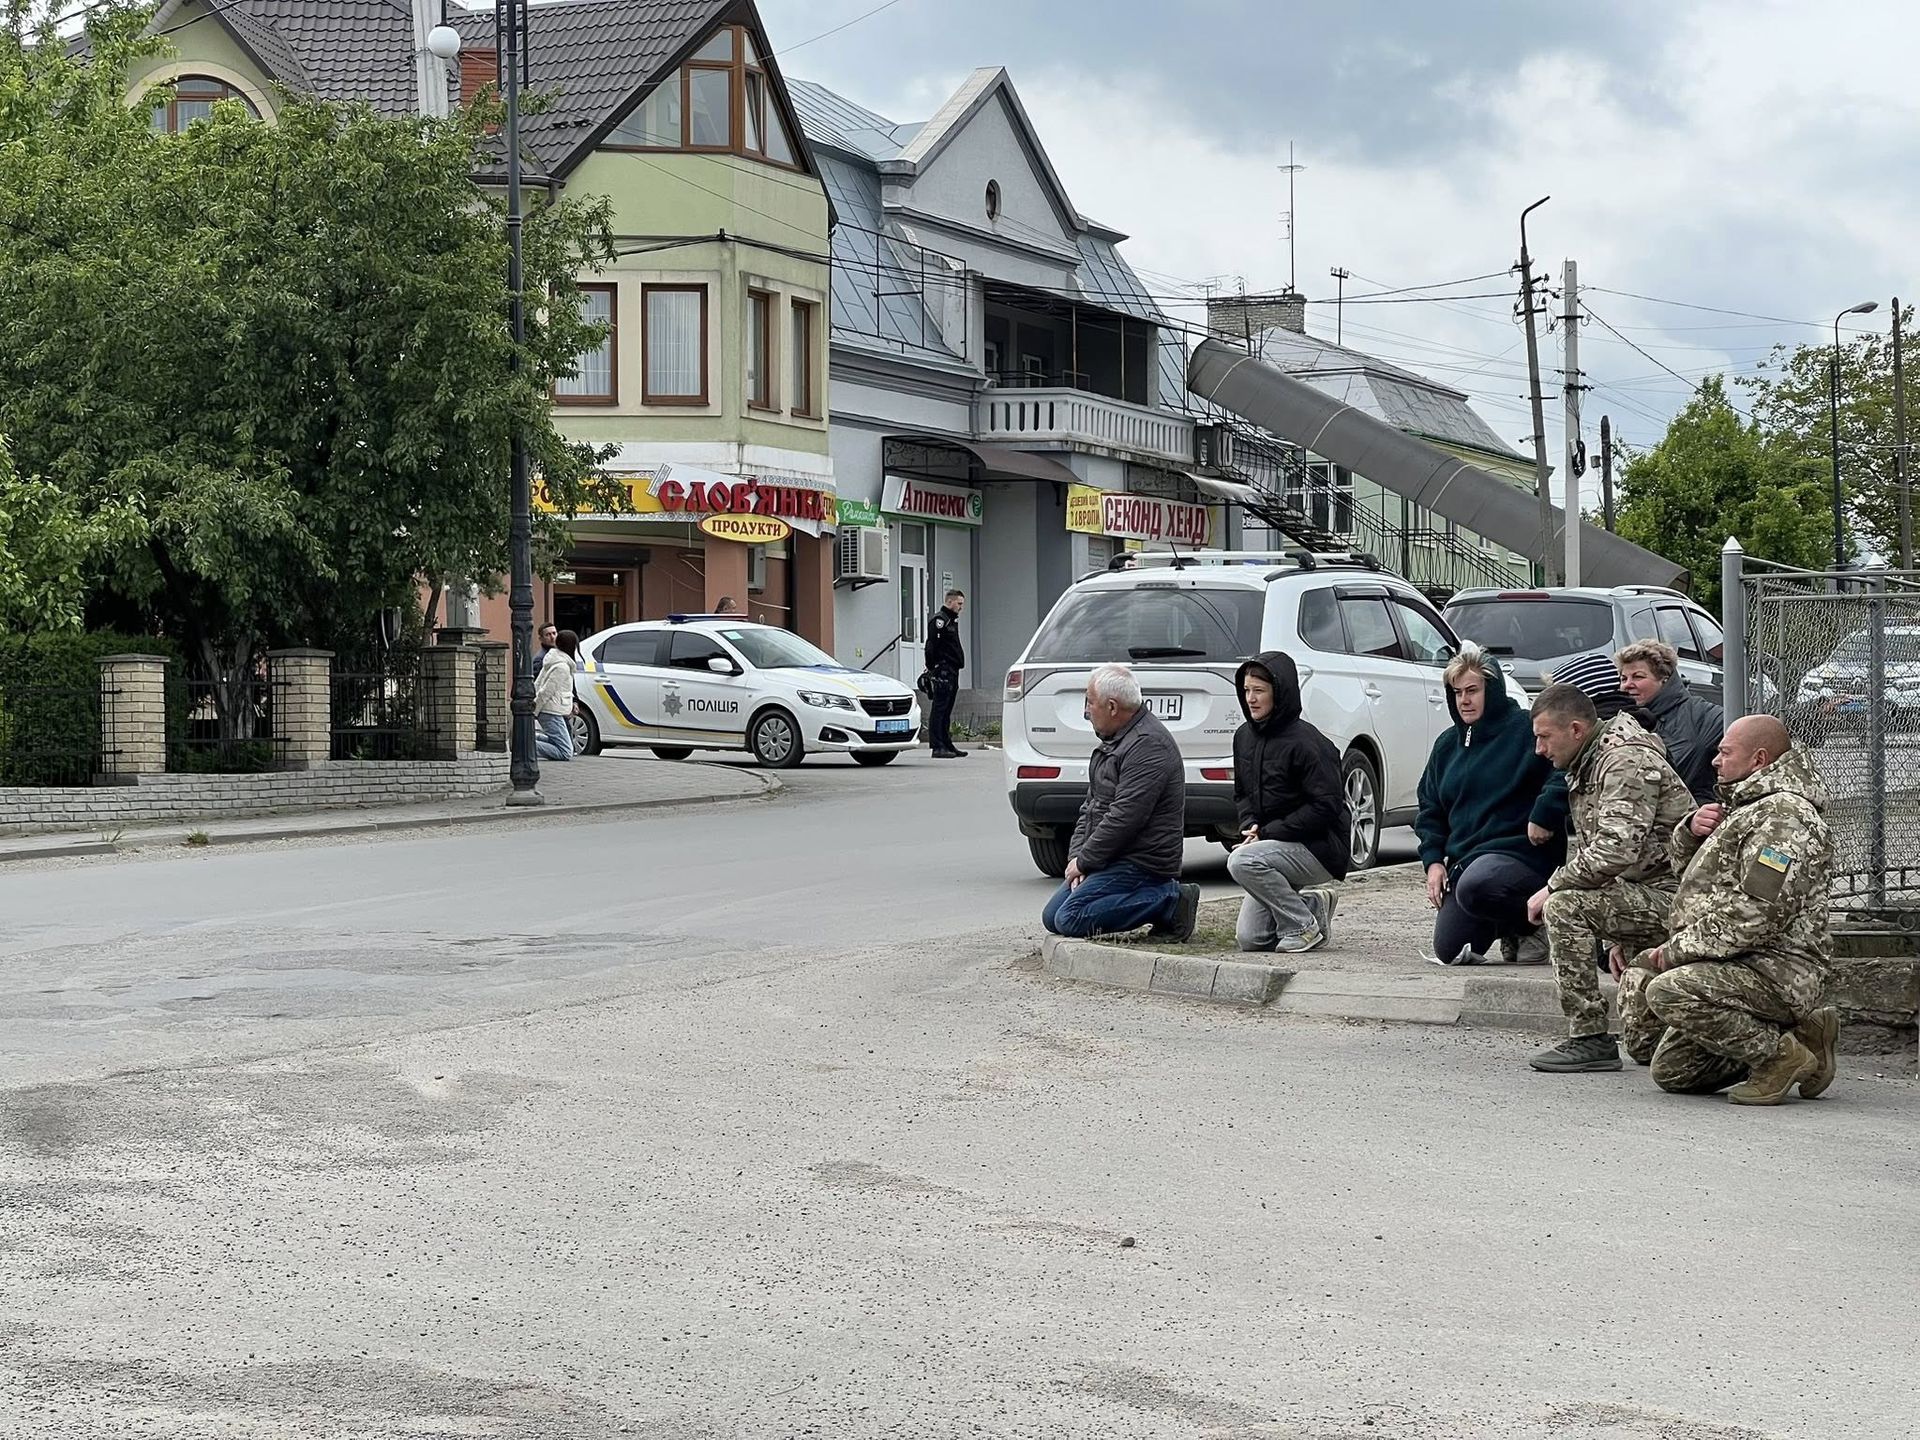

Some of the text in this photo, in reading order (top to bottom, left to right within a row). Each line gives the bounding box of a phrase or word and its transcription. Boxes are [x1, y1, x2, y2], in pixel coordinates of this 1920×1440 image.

[898, 480, 966, 518] Аптека
[712, 519, 781, 537] ПРОДУКТИ
[1105, 497, 1206, 544] СЕКОНД ХЕНД
[687, 698, 739, 713] ПОЛІЦІЯ
